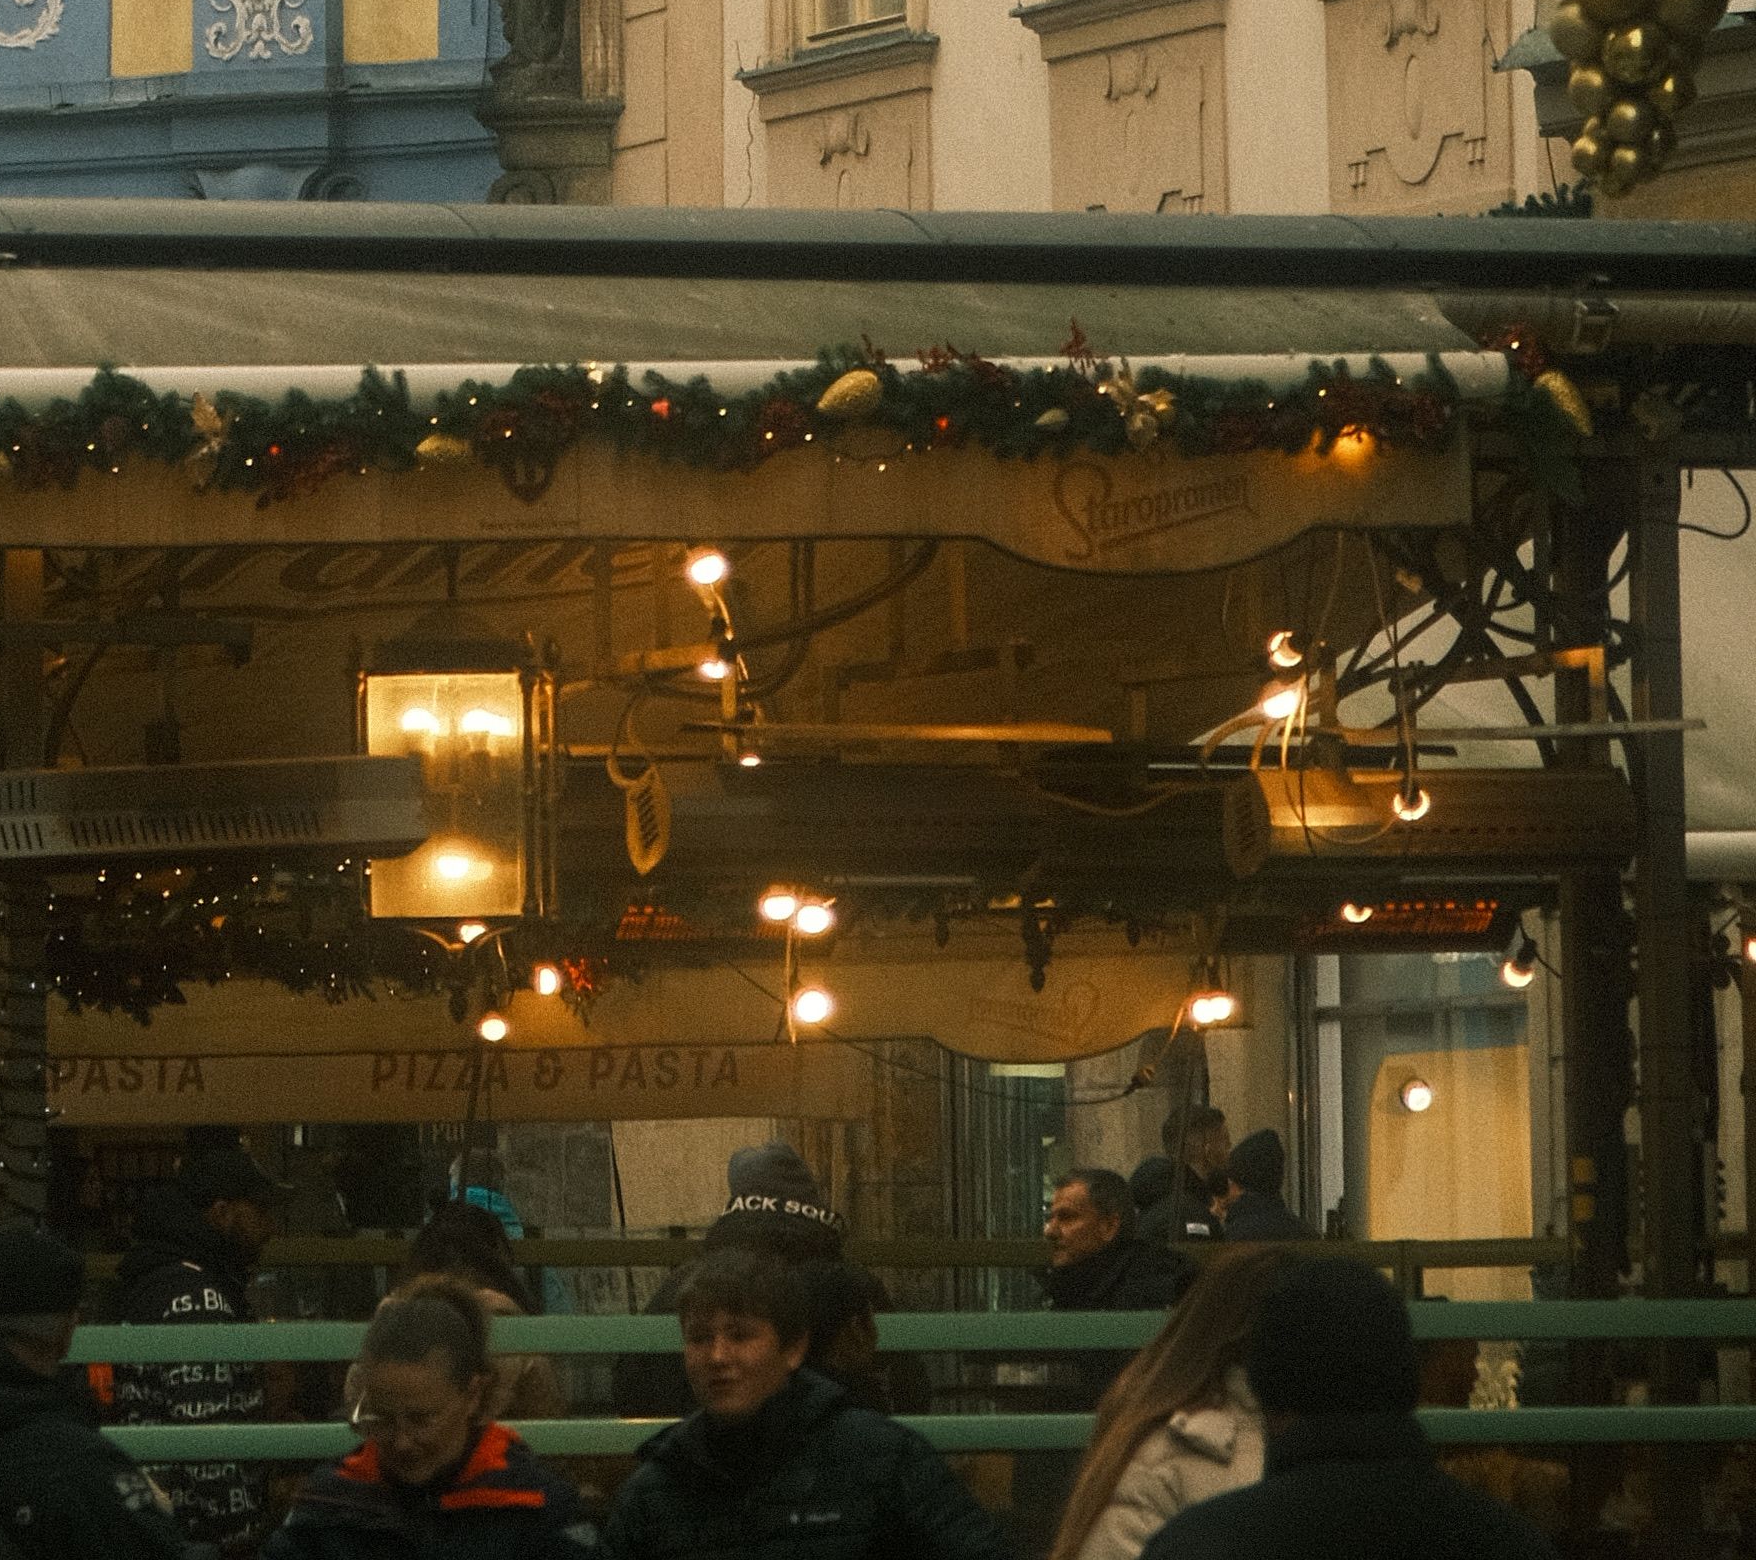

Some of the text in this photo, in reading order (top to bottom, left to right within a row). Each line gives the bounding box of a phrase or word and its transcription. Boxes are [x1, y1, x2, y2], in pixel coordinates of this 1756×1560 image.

[1053, 462, 1261, 560] Staropramen
[49, 1059, 204, 1093] PASTA
[370, 1048, 738, 1091] PIZZA & PASTA
